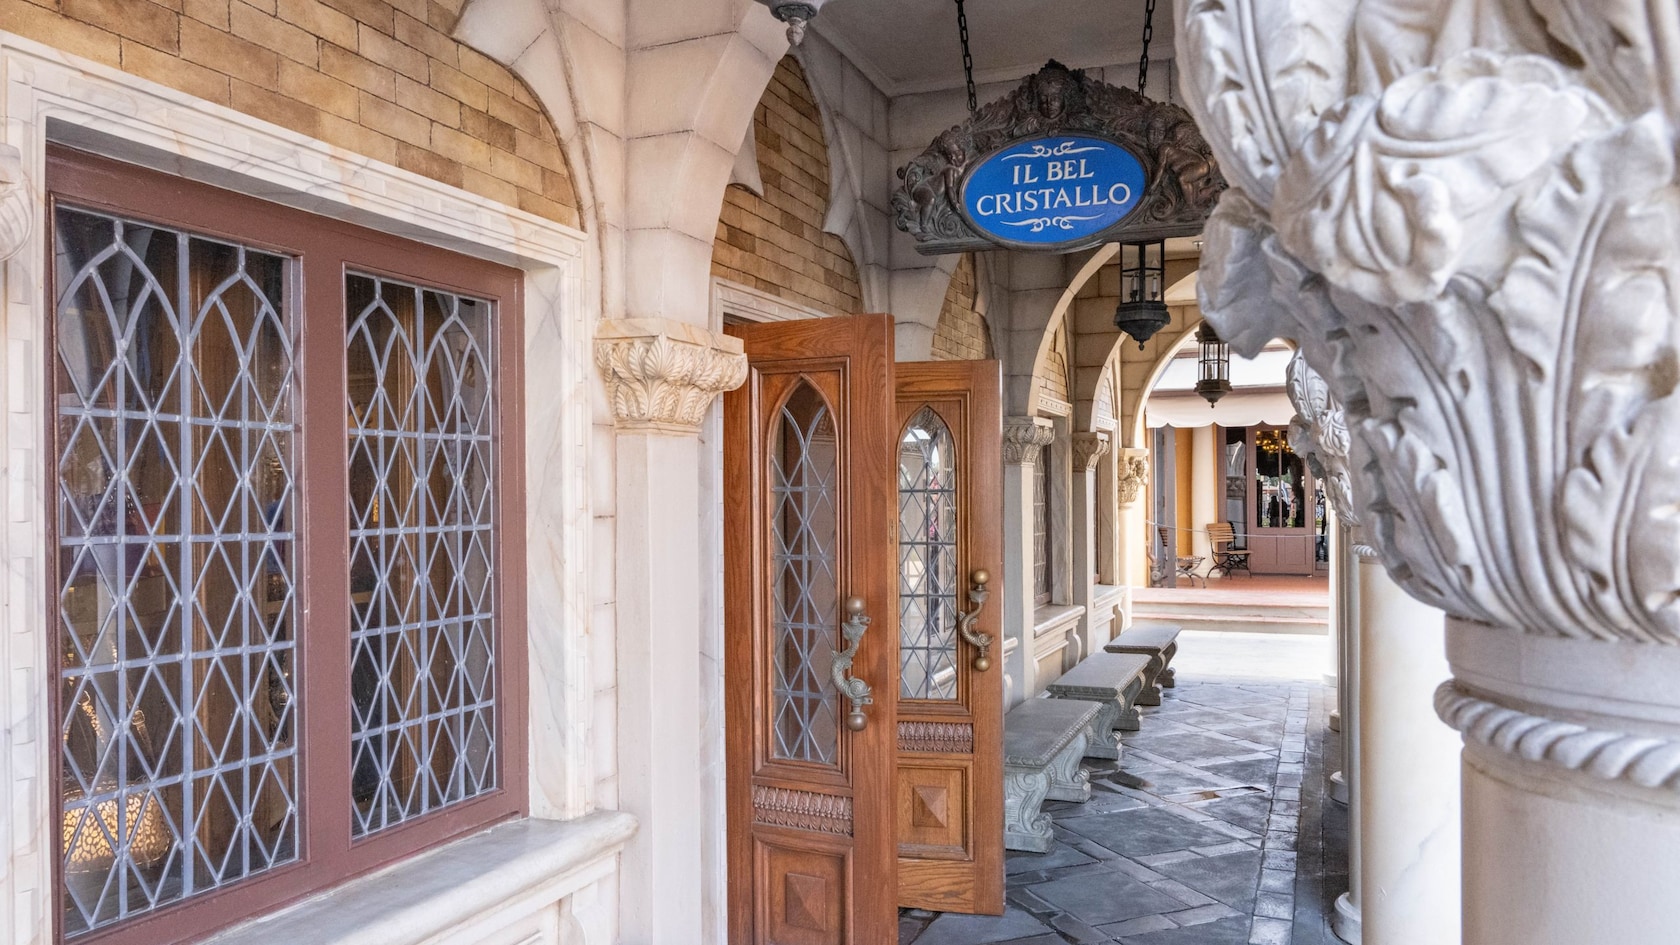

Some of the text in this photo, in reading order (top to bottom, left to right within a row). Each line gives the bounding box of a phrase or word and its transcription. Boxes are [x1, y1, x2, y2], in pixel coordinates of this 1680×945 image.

[1012, 158, 1095, 185] IL BEL
[976, 182, 1131, 216] CRISTALLO
